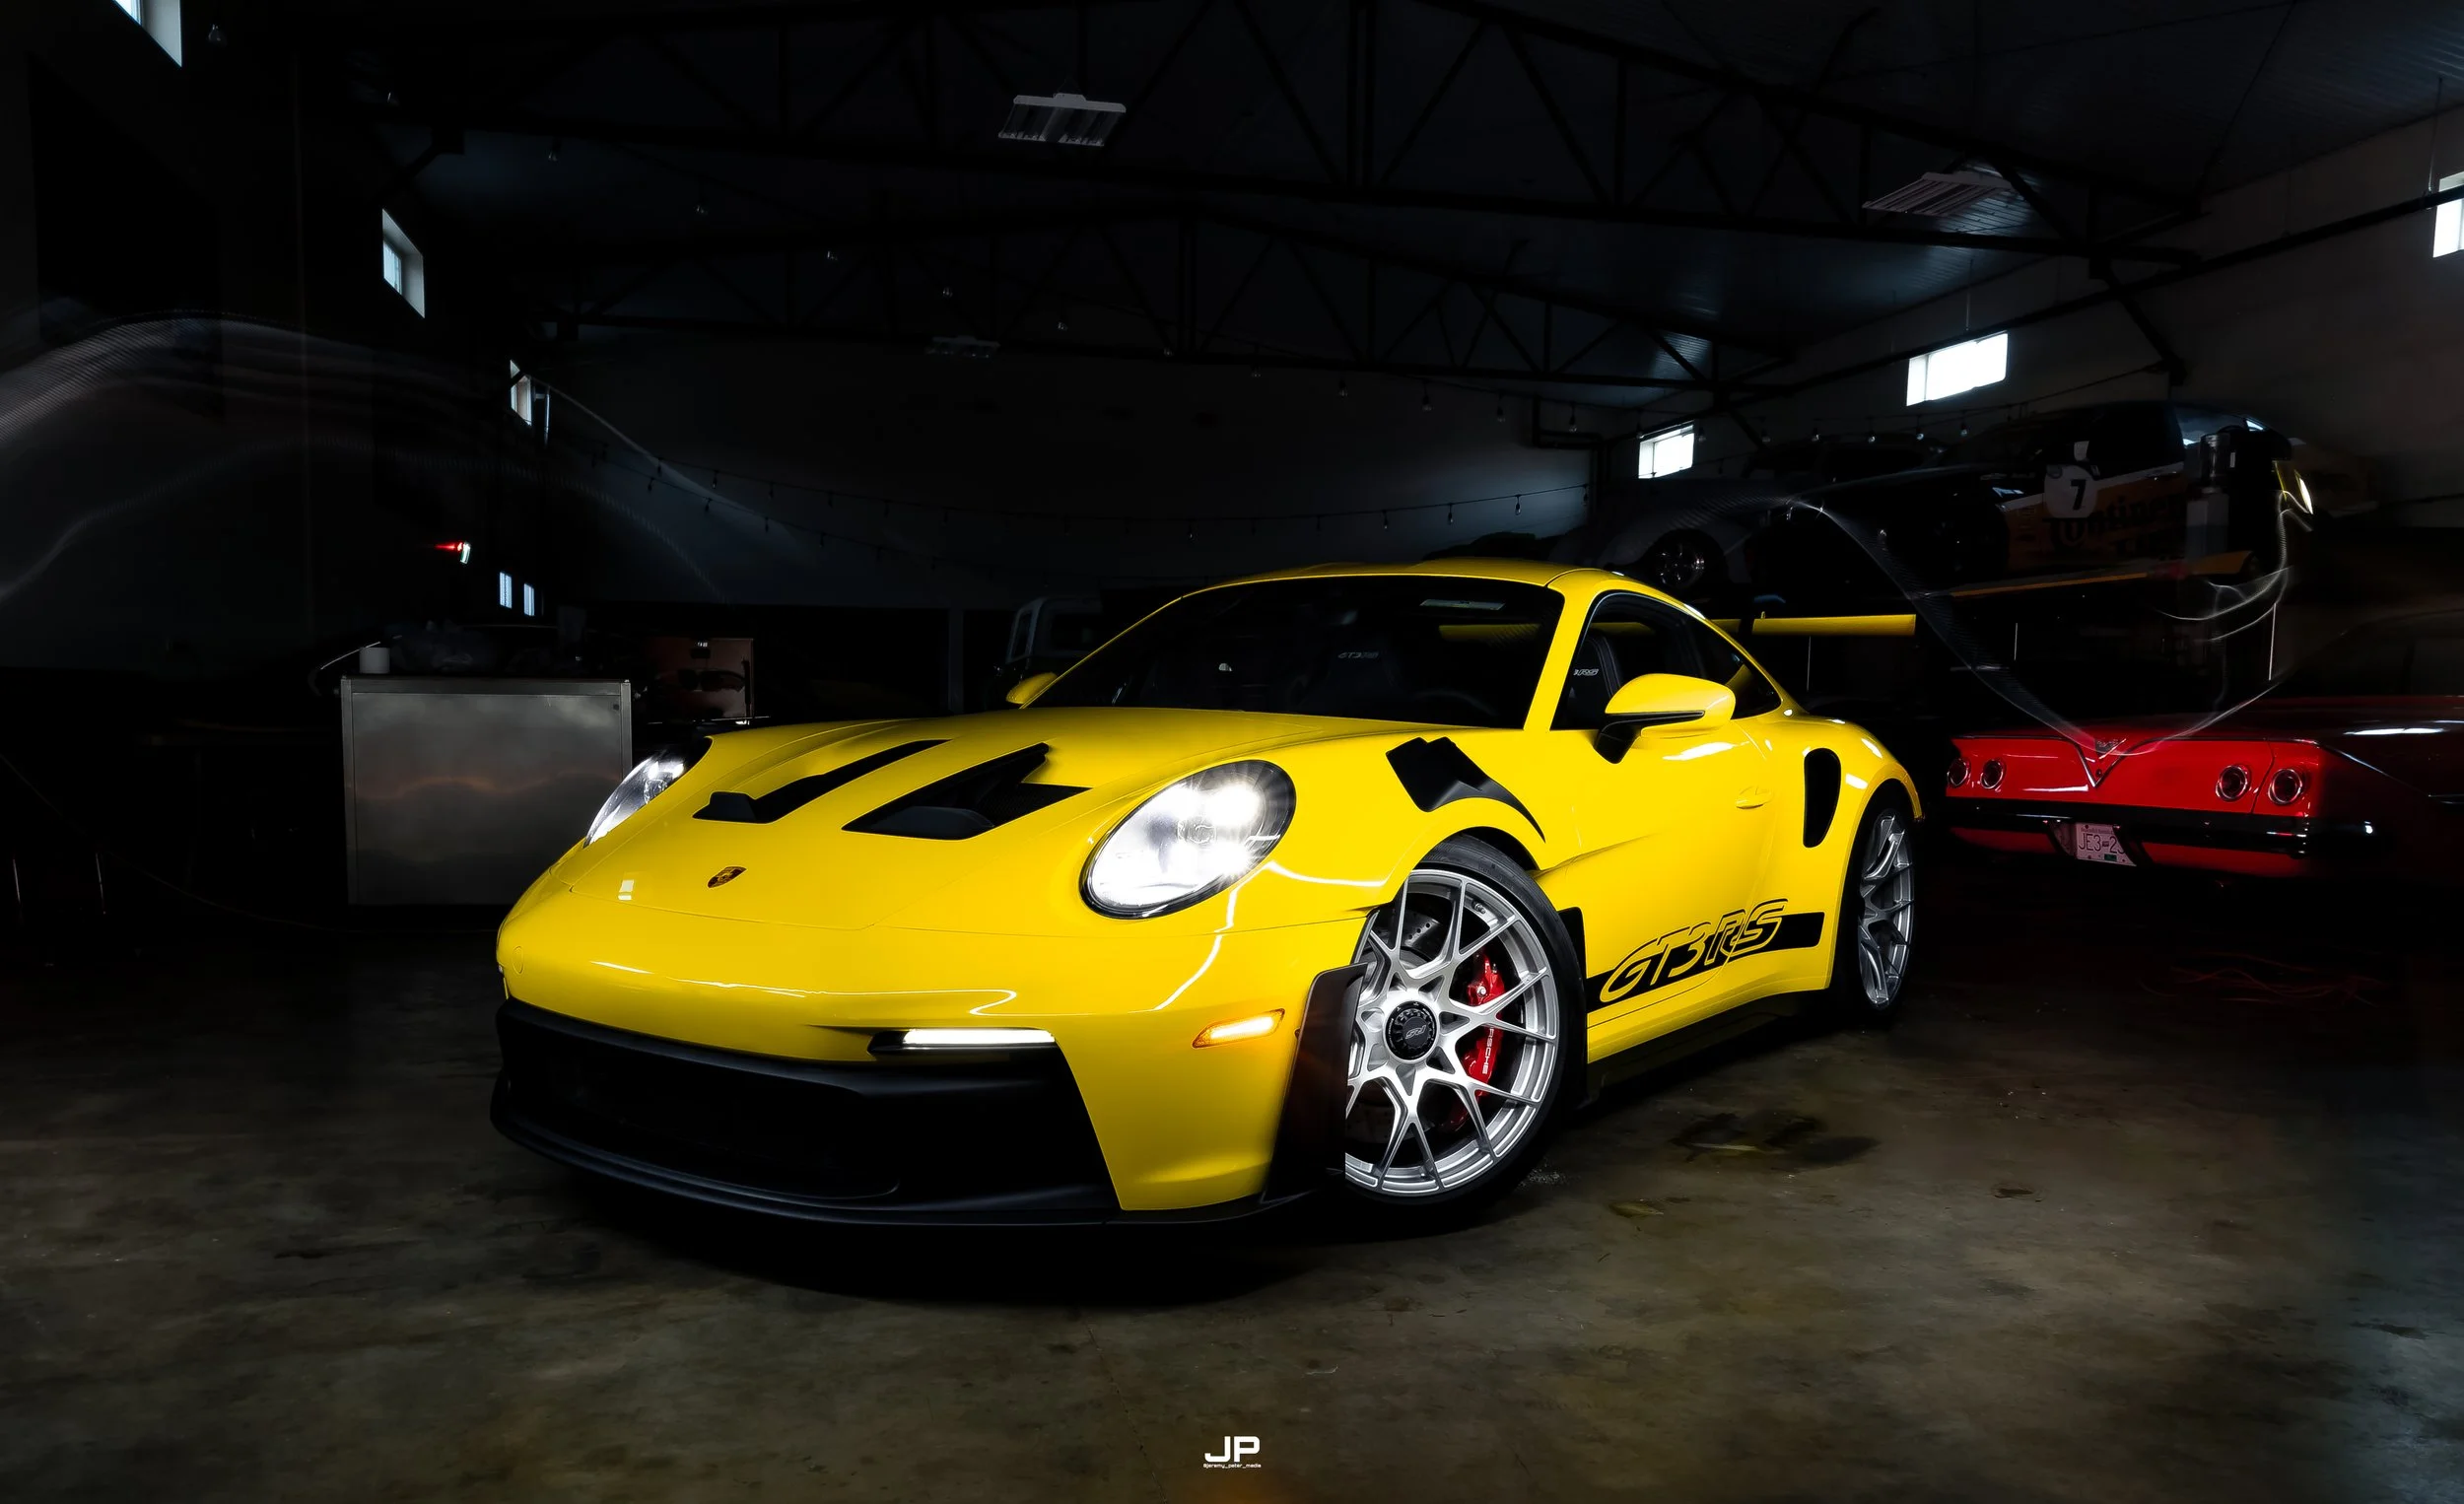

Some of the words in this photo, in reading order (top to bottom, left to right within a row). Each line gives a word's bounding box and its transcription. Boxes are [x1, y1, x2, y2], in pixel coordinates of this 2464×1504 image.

[2071, 479, 2087, 511] 7
[1337, 650, 1380, 659] GT3
[1482, 1028, 1495, 1074] RSCHE
